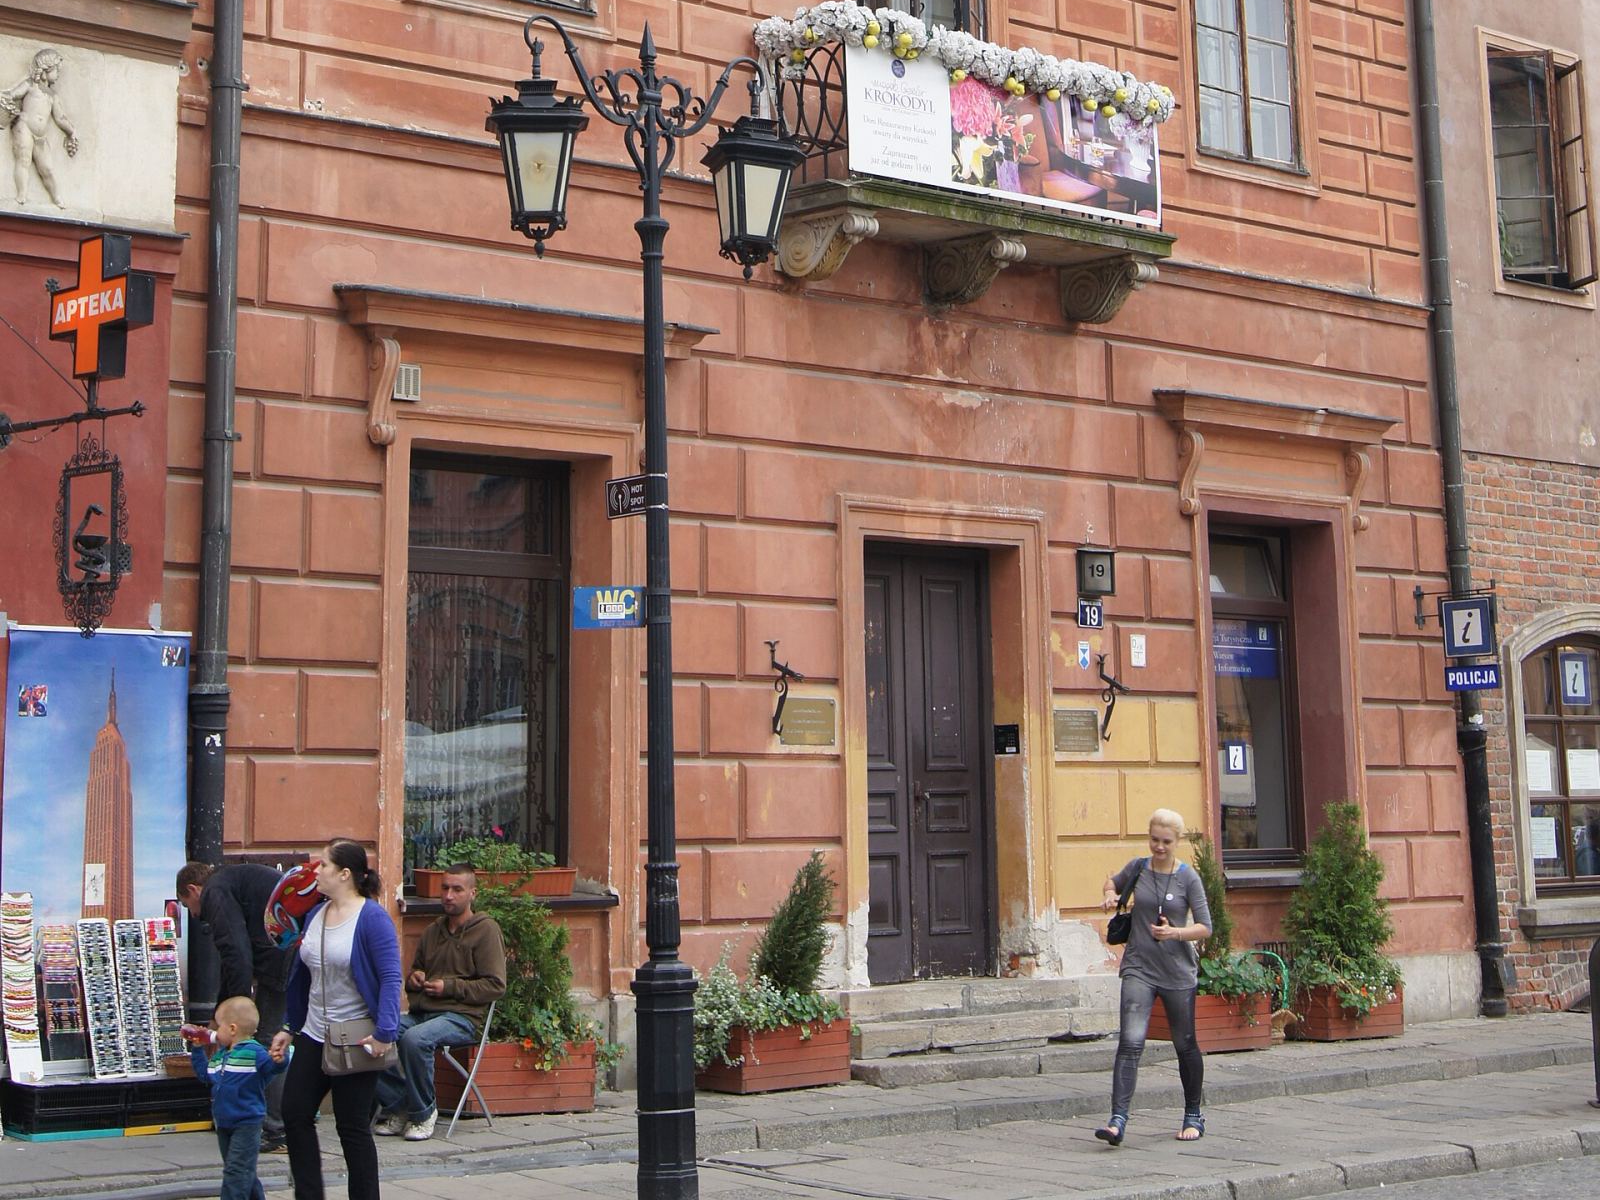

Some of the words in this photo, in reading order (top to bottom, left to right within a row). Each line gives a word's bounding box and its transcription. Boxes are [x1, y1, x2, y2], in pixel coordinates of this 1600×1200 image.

[864, 87, 936, 113] KROKODYL
[54, 287, 124, 325] APTEKA
[630, 484, 643, 494] HOT
[630, 496, 645, 506] SPOT
[1088, 564, 1105, 578] 19
[596, 589, 636, 615] WC
[1085, 606, 1098, 626] 19
[1448, 669, 1497, 686] POLICJA
